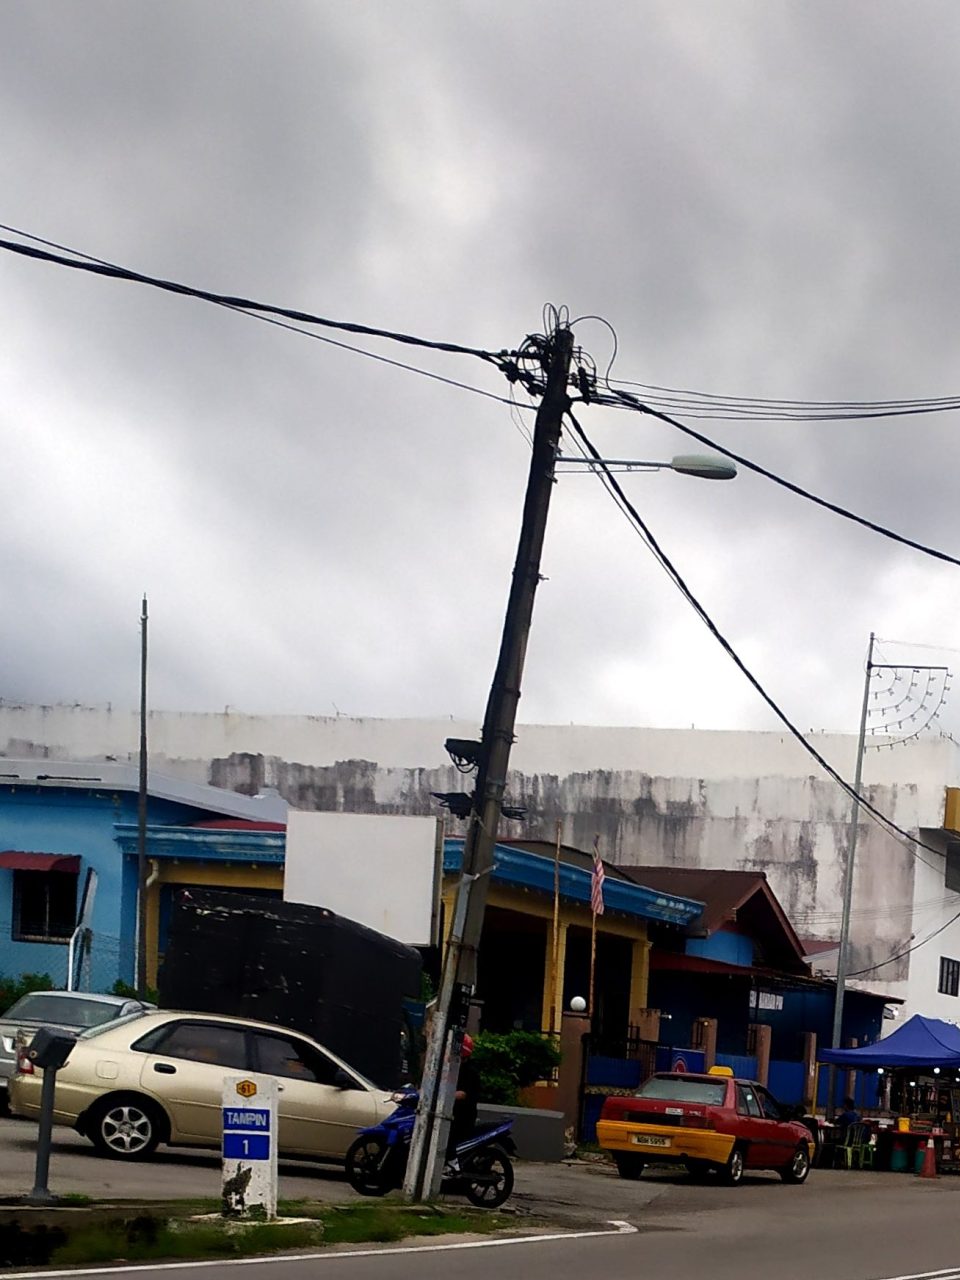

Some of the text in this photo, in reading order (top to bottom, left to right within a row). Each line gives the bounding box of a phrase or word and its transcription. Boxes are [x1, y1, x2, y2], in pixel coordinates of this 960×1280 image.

[241, 1084, 251, 1094] 61
[226, 1112, 267, 1126] TAMPIN
[242, 1139, 249, 1155] 1
